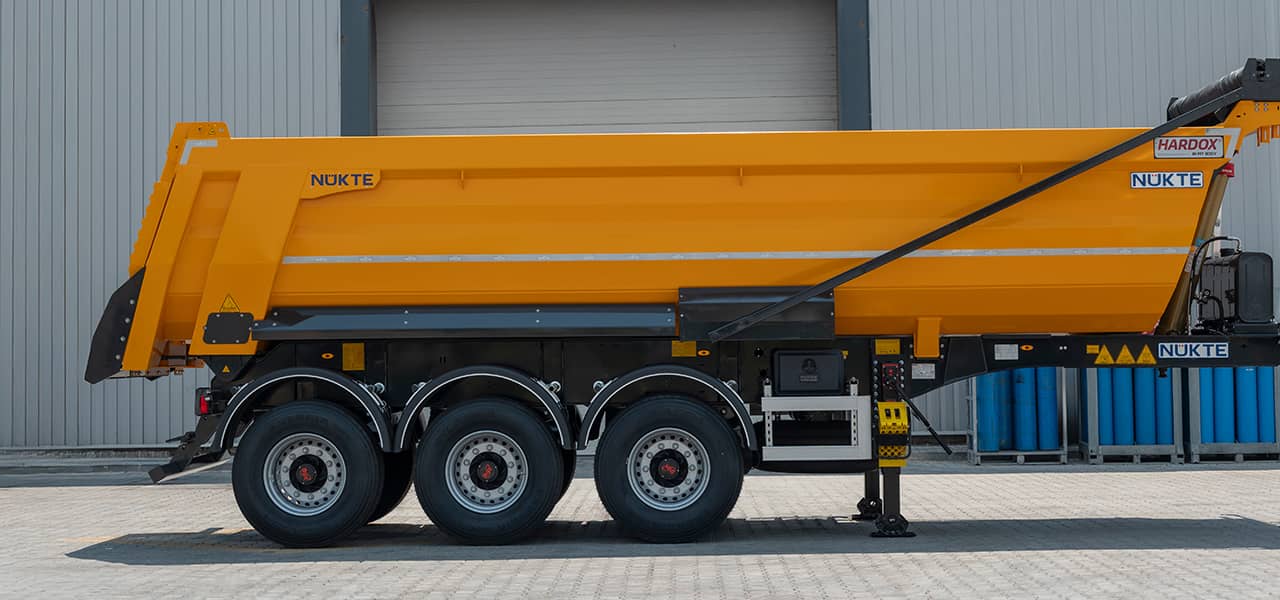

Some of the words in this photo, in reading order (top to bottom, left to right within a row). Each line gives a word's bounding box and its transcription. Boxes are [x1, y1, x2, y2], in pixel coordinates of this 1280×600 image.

[1158, 138, 1218, 150] HARDOX
[311, 173, 374, 186] NÜKTE
[1132, 173, 1202, 187] NÜKTE
[1160, 343, 1227, 357] NÜKTE
